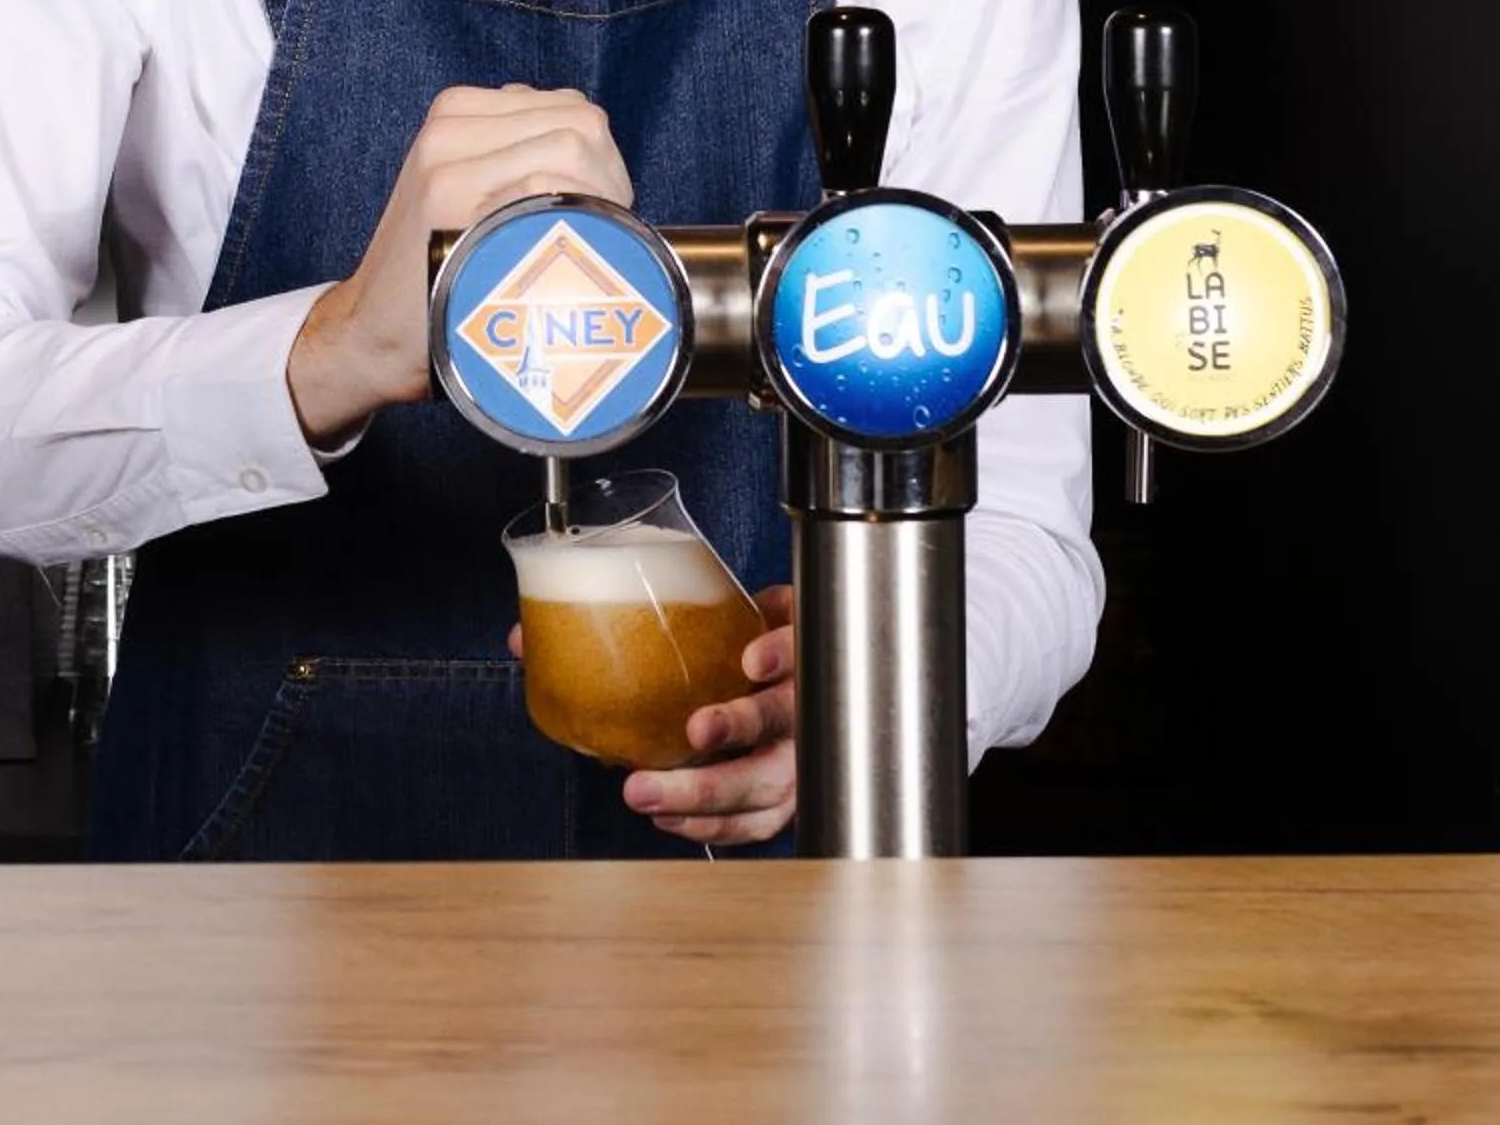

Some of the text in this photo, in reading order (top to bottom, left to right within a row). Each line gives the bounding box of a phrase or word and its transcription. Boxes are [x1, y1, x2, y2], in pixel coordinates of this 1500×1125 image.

[1185, 271, 1226, 300] LA
[802, 269, 975, 365] Eau
[1188, 305, 1228, 335] BI
[1186, 340, 1232, 372] SE
